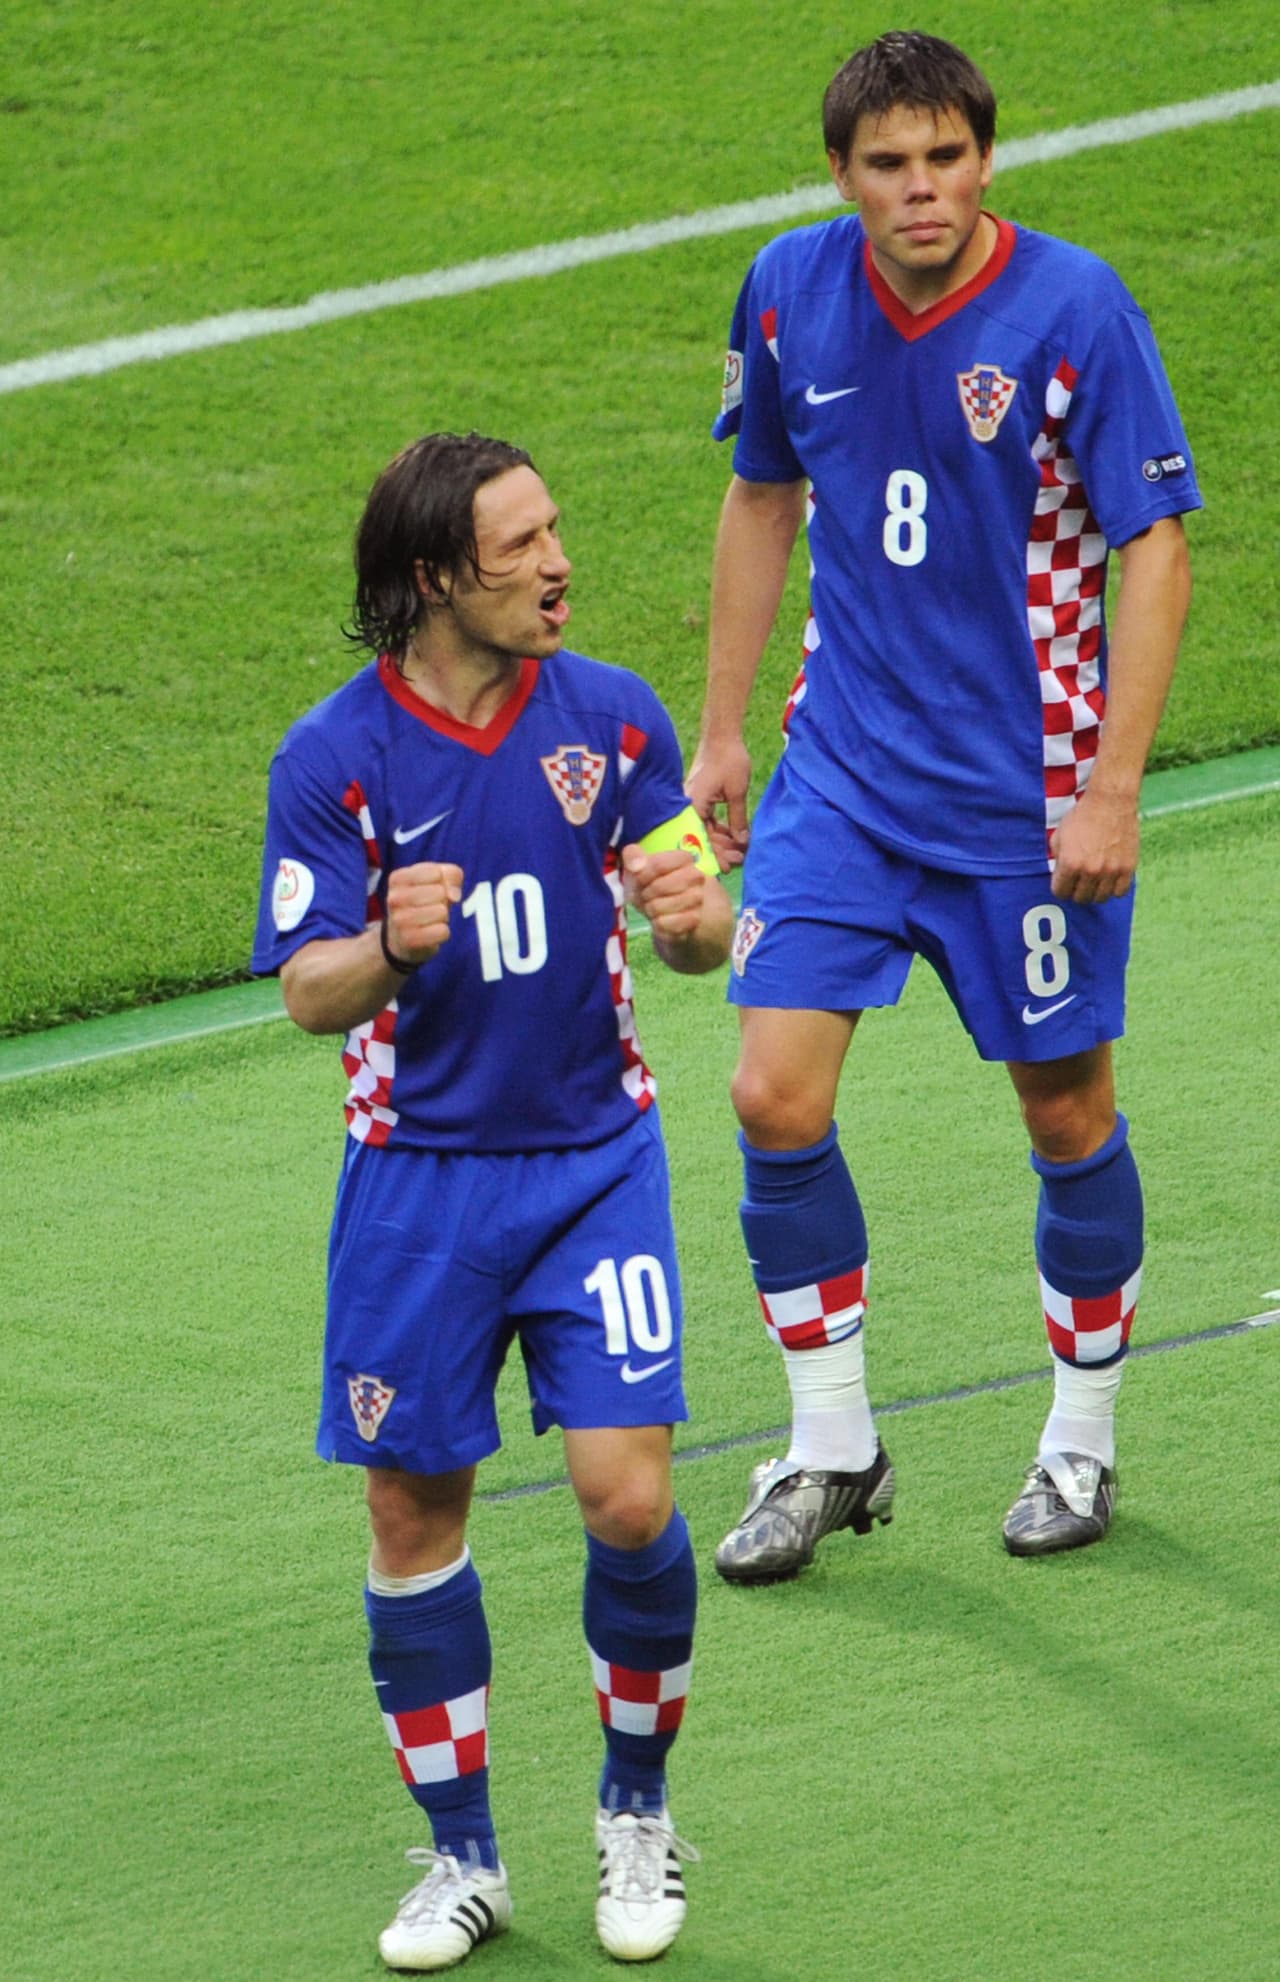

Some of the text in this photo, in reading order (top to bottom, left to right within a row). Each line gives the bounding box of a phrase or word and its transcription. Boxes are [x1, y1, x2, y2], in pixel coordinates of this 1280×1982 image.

[883, 469, 928, 567] 8
[461, 872, 548, 983] 10
[1023, 904, 1070, 998] 8
[583, 1254, 673, 1356] 10
